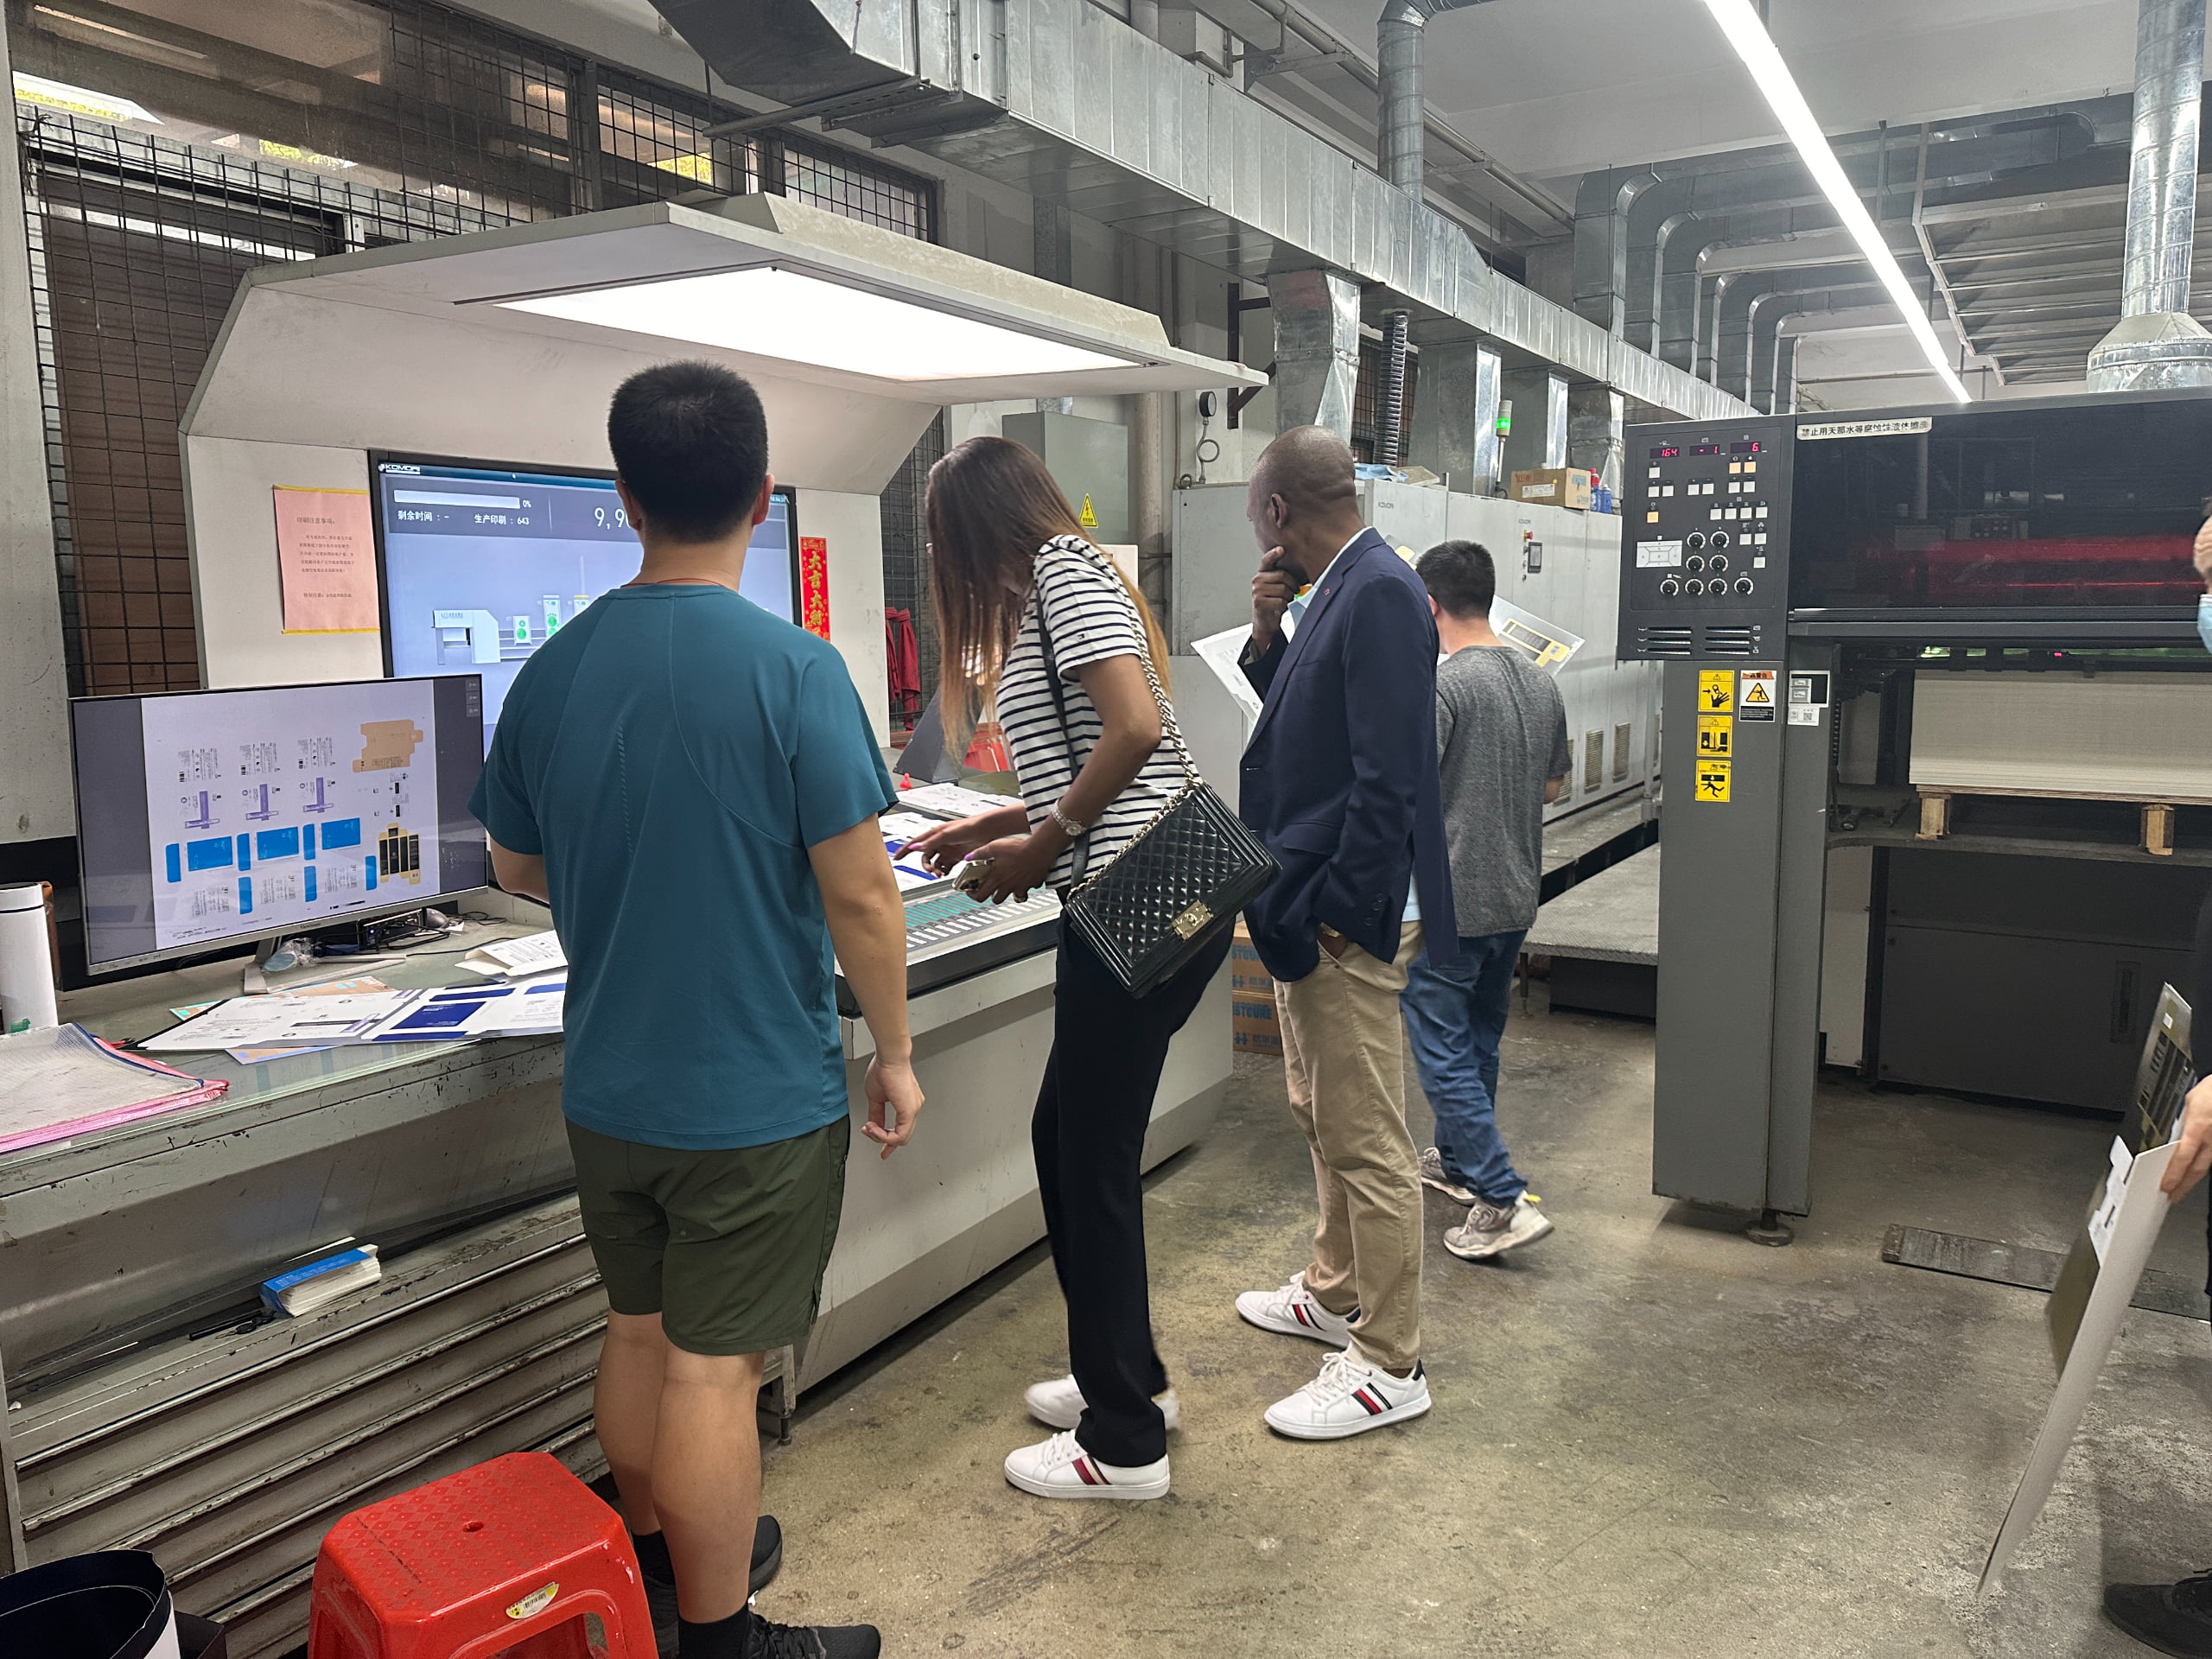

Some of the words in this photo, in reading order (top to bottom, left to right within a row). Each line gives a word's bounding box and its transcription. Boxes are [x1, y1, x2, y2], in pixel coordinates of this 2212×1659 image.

[1661, 448, 1678, 457] 164
[385, 463, 420, 472] KOMORI
[522, 499, 532, 508] 0%
[517, 517, 530, 525] 643
